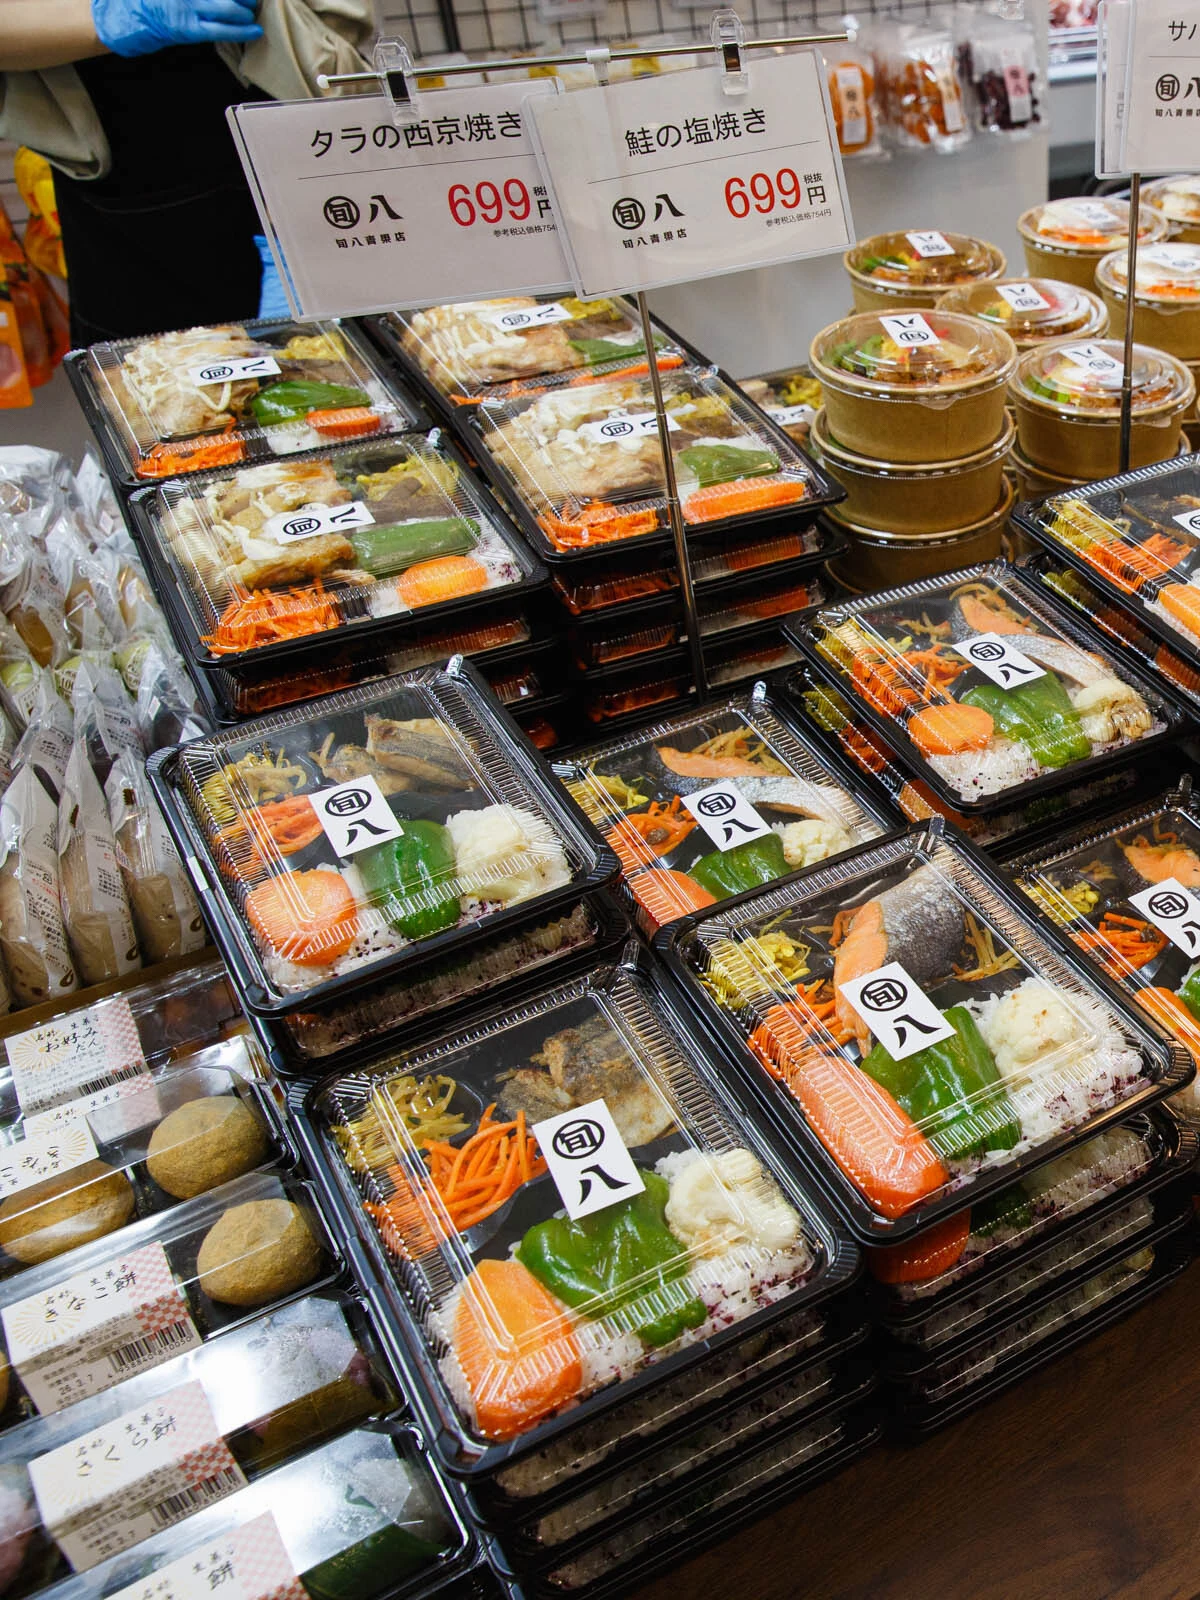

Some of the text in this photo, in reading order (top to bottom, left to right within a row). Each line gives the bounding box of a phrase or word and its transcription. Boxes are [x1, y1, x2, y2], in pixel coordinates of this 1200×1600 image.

[310, 111, 522, 158] タラの西京焼き
[624, 107, 767, 157] 鮭の塩焼き
[448, 178, 532, 227] 699
[724, 168, 828, 219] 699 円
[803, 173, 823, 185] 税抜
[323, 194, 404, 229] 旬八
[493, 223, 557, 238] 参考税込価格754
[612, 193, 686, 230] 旬八
[969, 641, 1035, 684] 旬八
[324, 788, 393, 848] 旬八
[697, 792, 760, 843] 旬八
[860, 978, 943, 1048] 旬八
[552, 1118, 631, 1206] 旬八
[45, 1271, 137, 1323] きなこ餅
[77, 1415, 177, 1477] さくら餅
